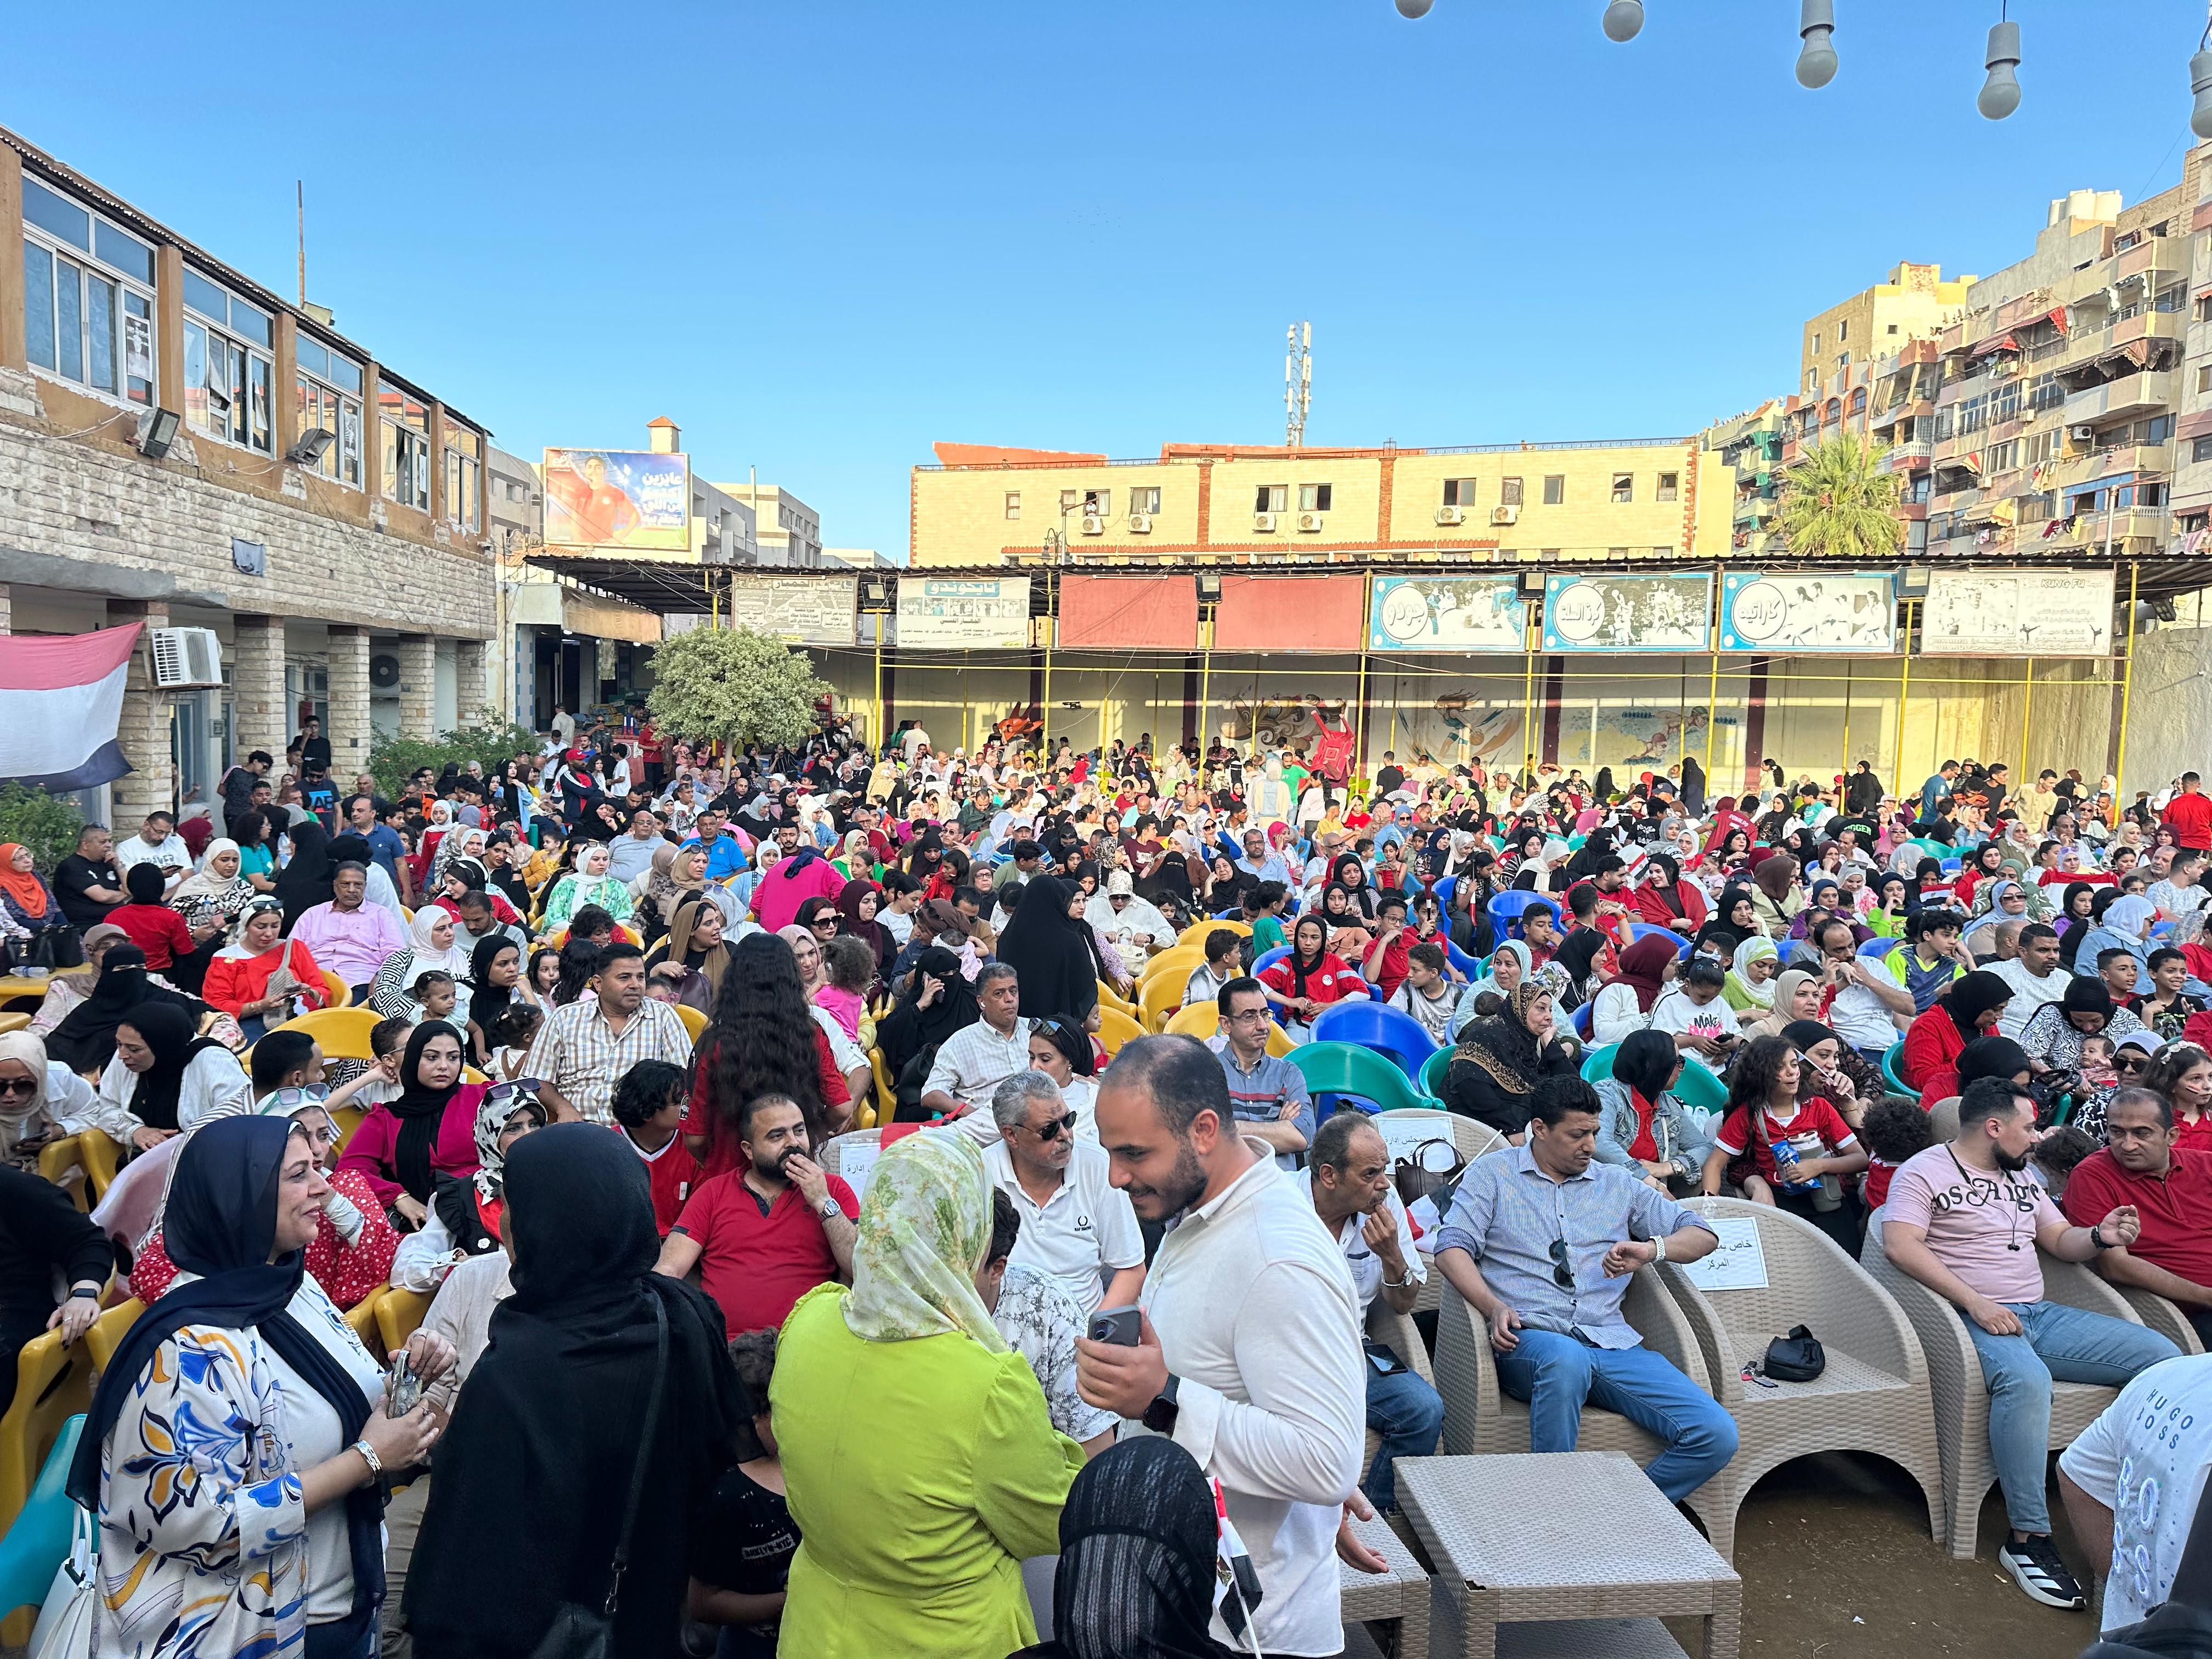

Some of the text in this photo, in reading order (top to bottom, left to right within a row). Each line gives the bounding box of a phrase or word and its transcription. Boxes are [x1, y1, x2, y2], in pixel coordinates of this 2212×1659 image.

[929, 582, 996, 595] تايكوندو
[2041, 579, 2071, 588] KUNG
[2071, 579, 2085, 589] FU
[1387, 602, 1425, 626] جودو
[1560, 600, 1601, 625] كرة السلة
[1738, 597, 1780, 625] كاراتيه
[1729, 1239, 1752, 1251] خاص
[1707, 1257, 1730, 1271] المركز
[2146, 1389, 2194, 1430] HUGO
